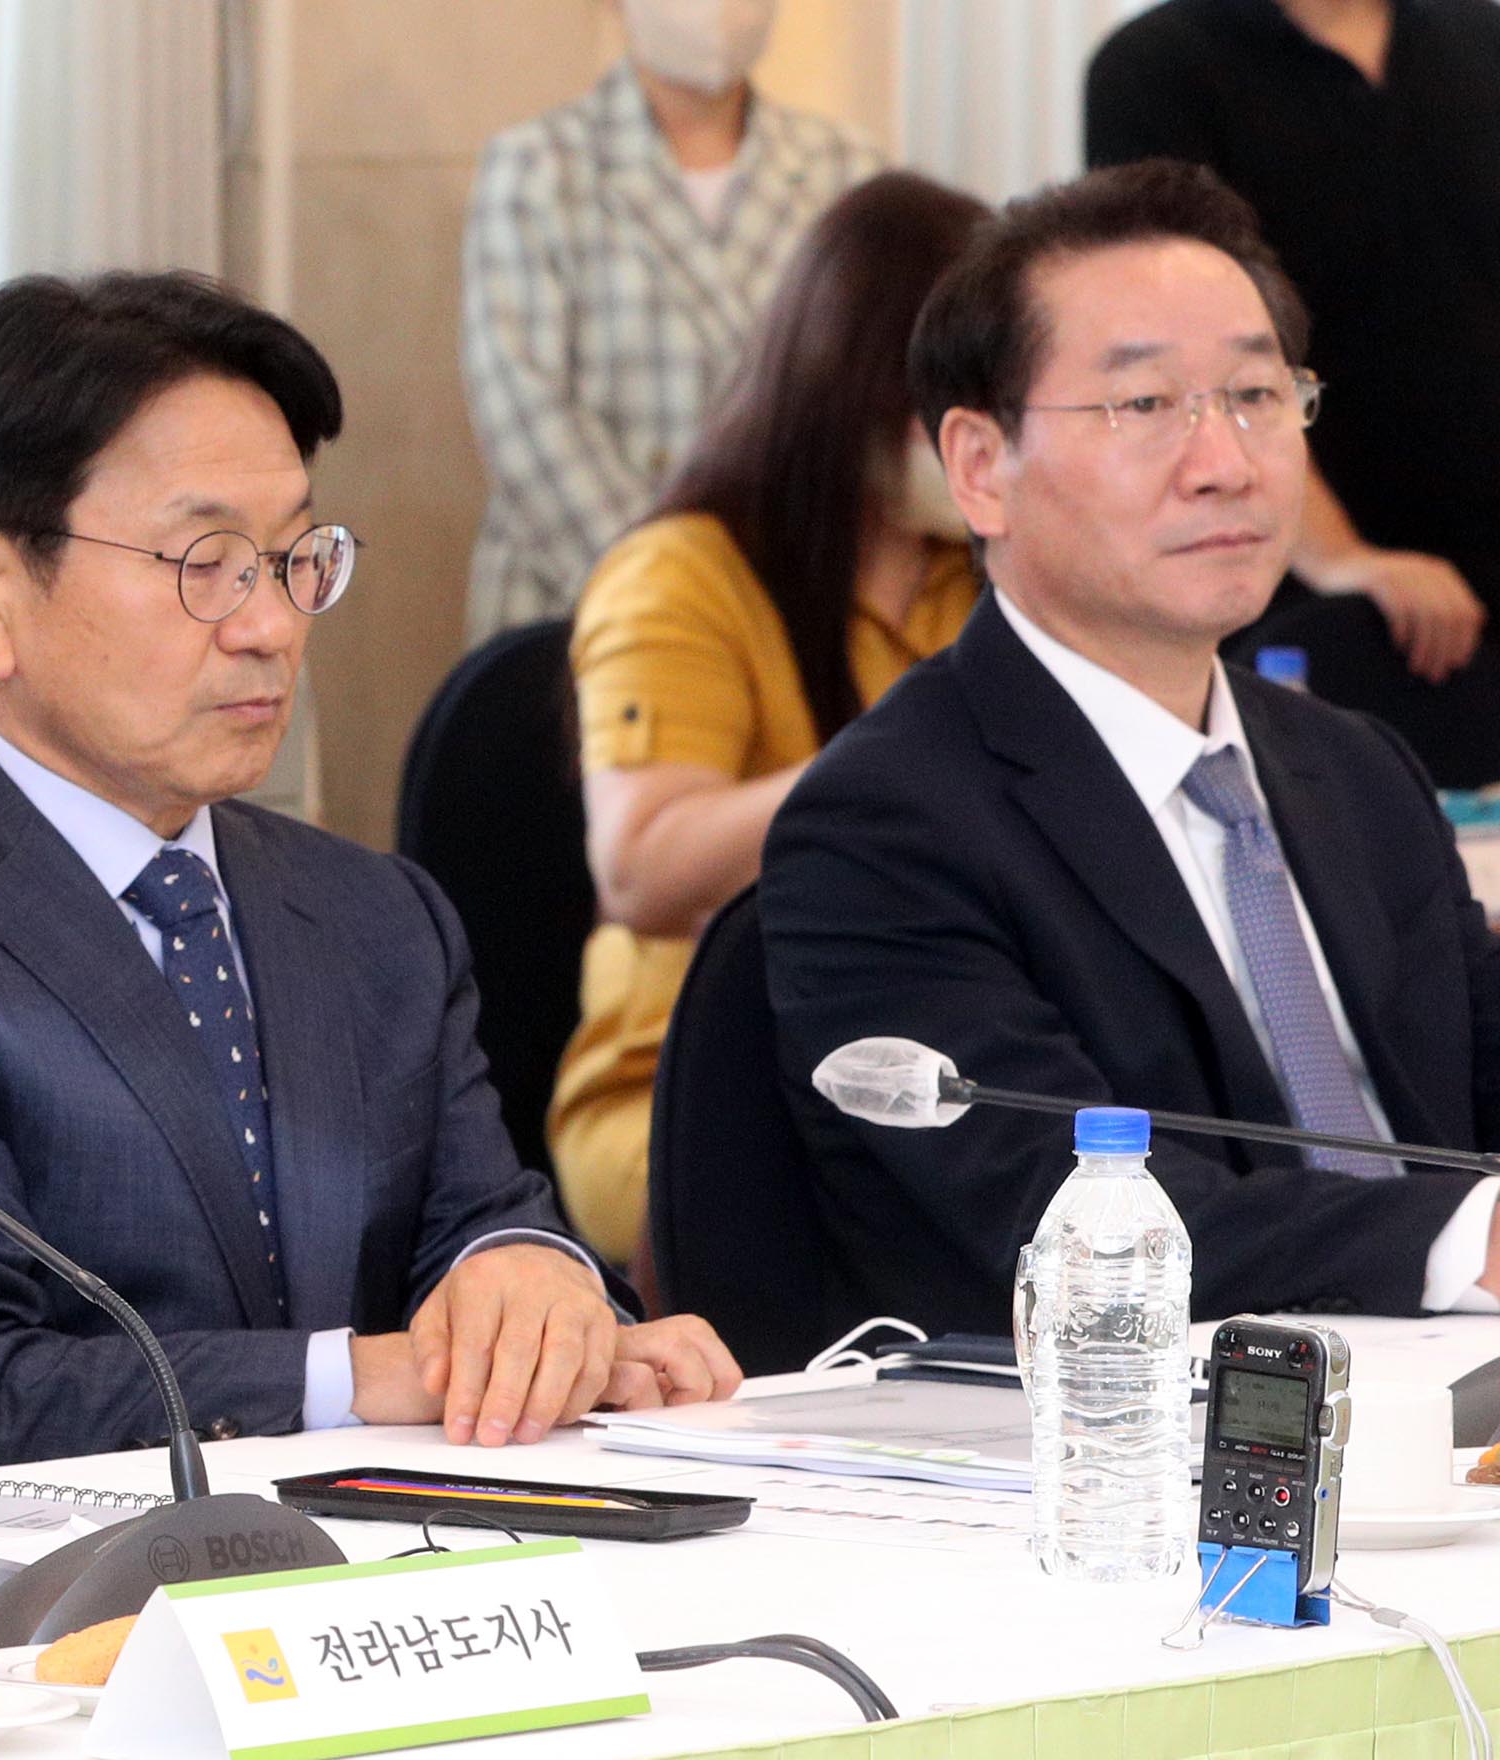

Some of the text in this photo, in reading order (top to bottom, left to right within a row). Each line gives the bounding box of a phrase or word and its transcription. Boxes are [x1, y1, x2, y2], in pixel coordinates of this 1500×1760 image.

[1247, 1345, 1282, 1359] SONY
[204, 1529, 306, 1570] BOSCH
[310, 1599, 572, 1682] 전라남도지사
